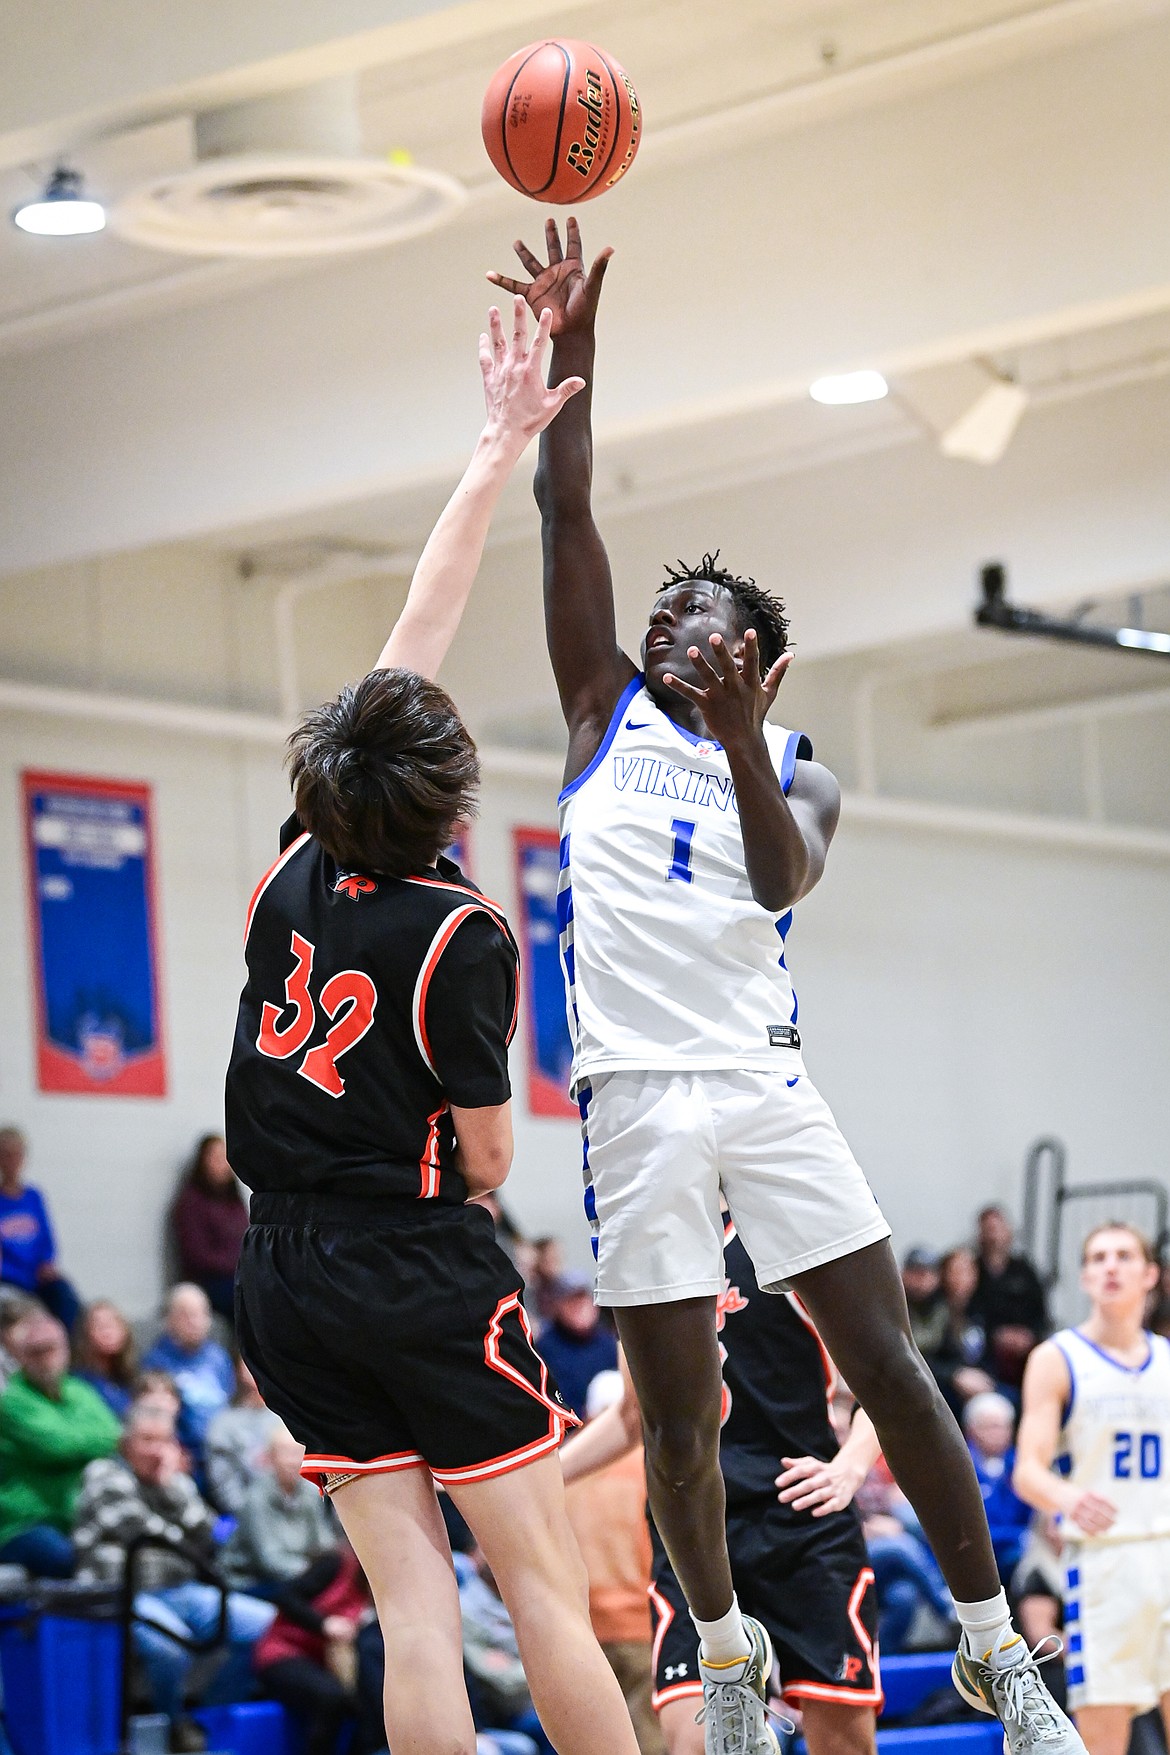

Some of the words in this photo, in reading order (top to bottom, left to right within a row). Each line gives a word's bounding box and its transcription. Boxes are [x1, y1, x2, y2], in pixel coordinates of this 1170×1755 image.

[510, 95, 522, 128] GAME
[566, 69, 603, 177] Baden
[614, 756, 739, 814] VIKIN
[665, 816, 698, 884] 1
[256, 930, 377, 1098] 32
[1114, 1432, 1161, 1478] 20
